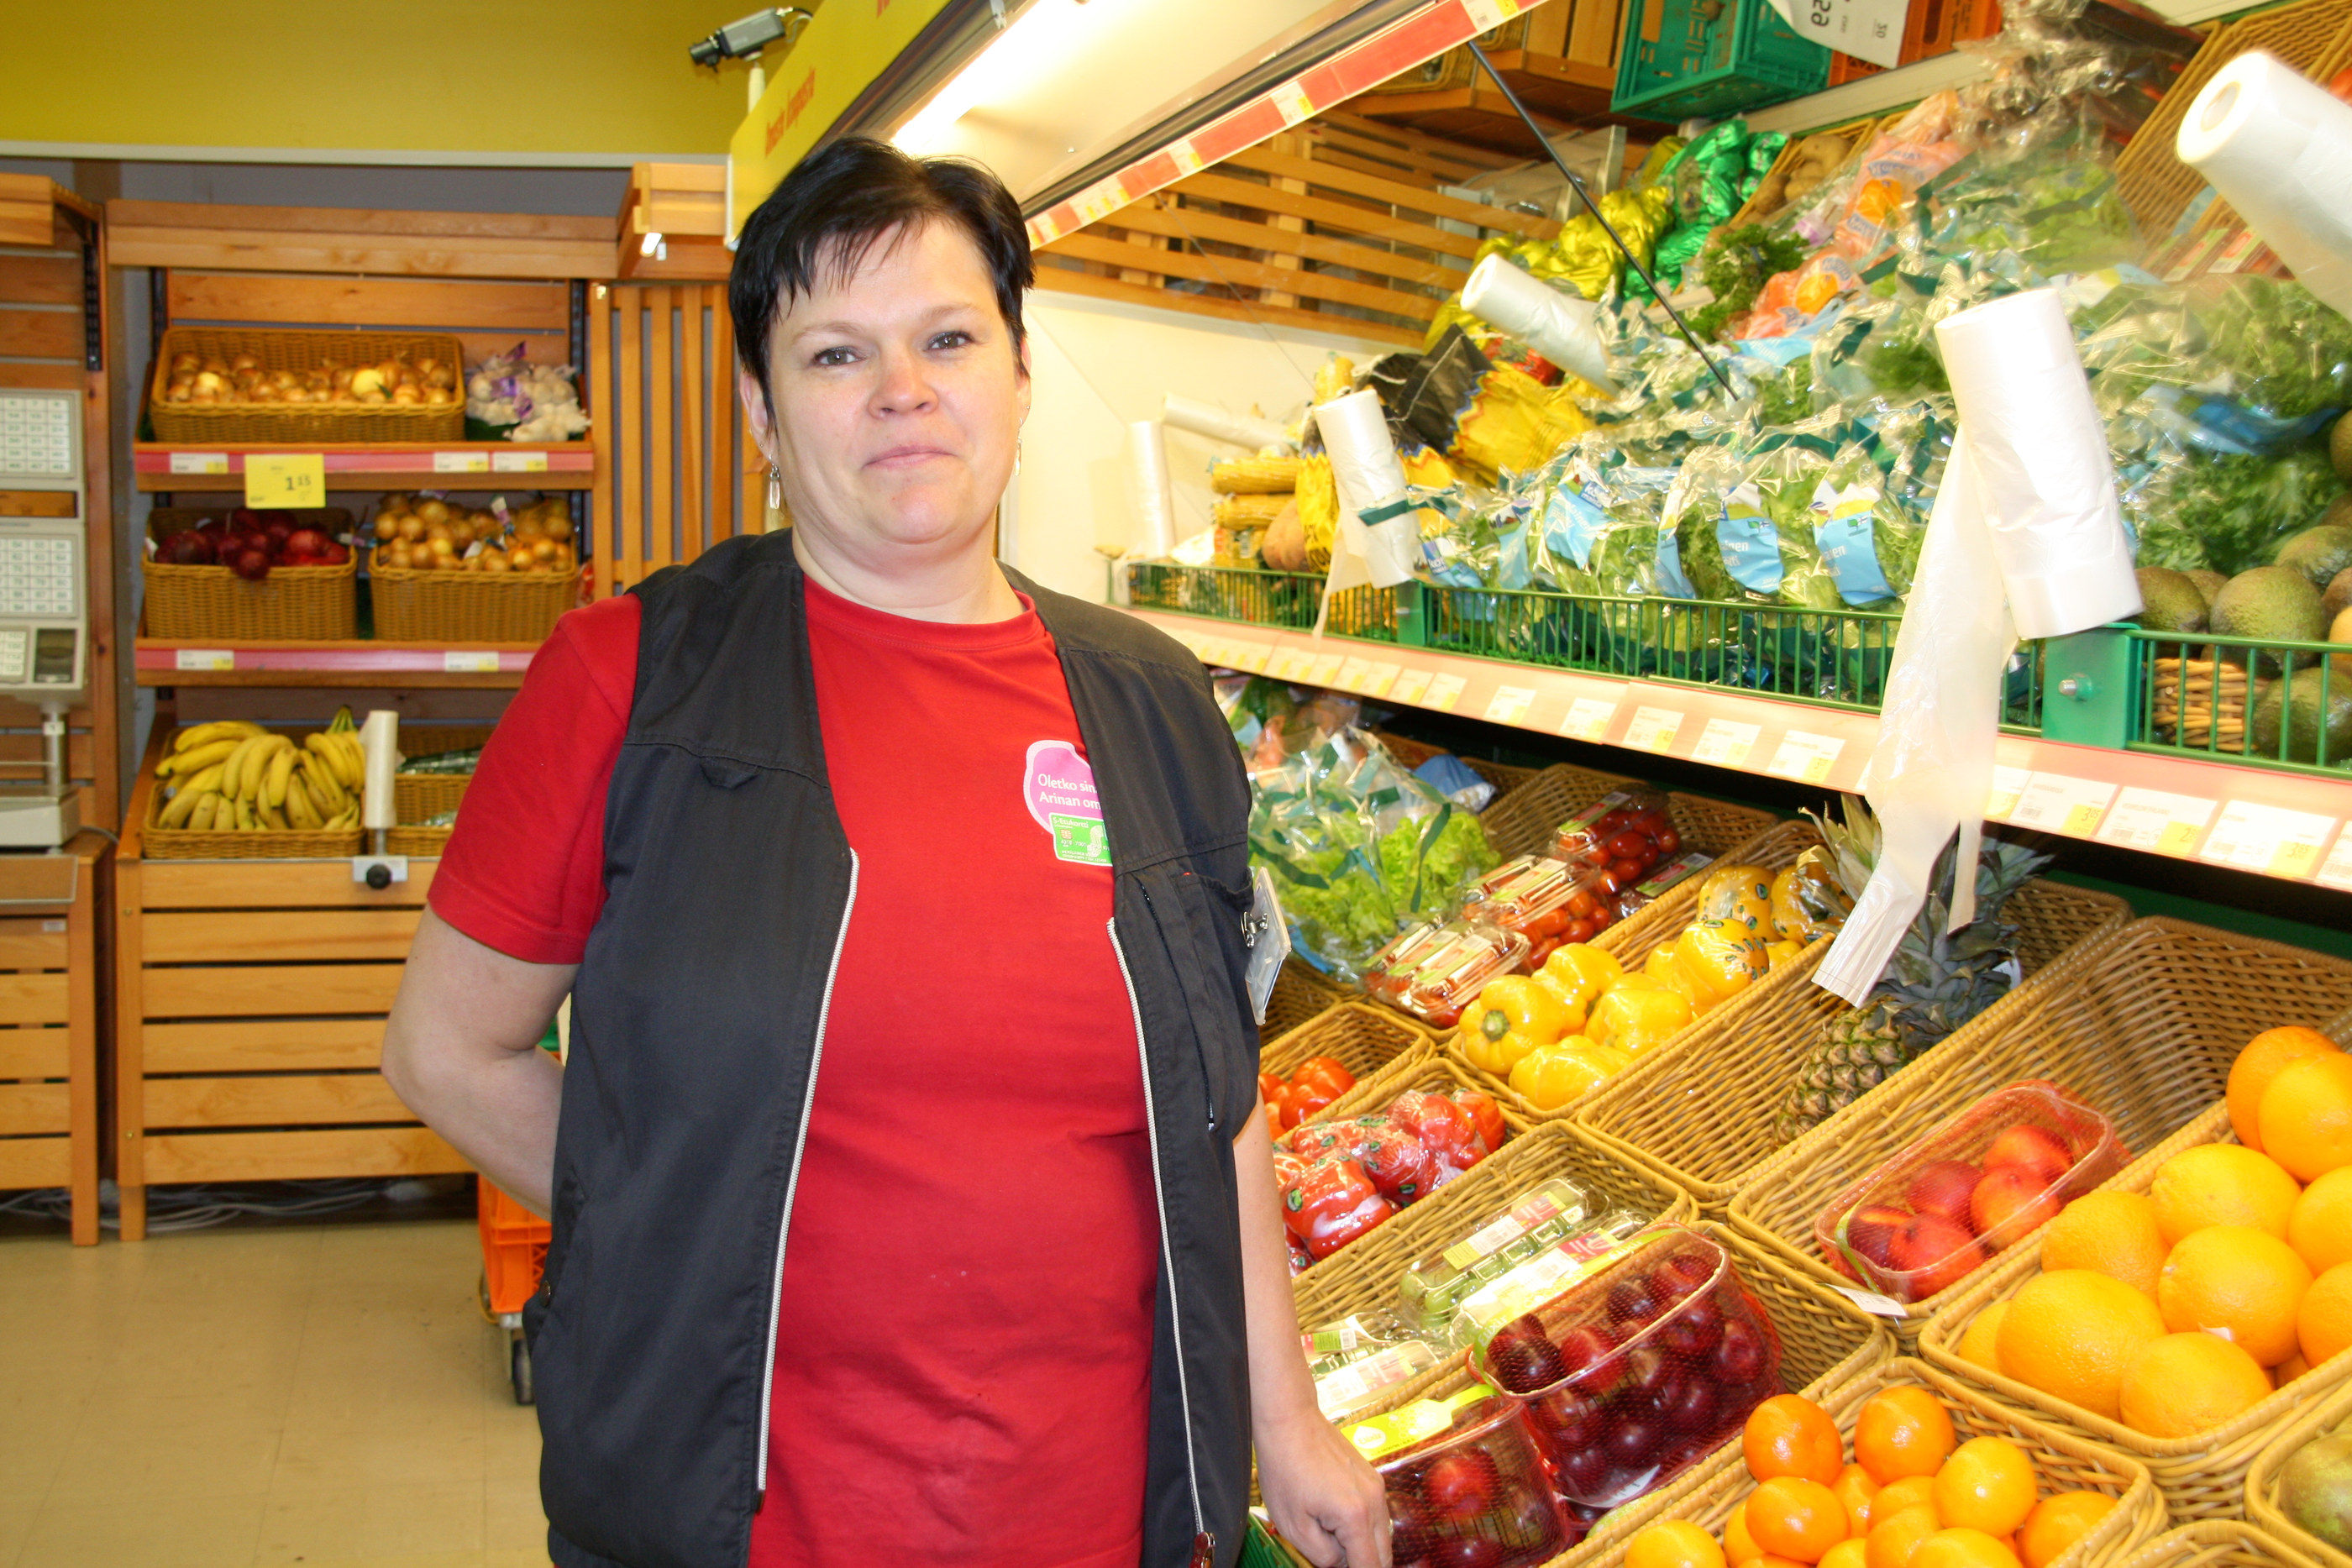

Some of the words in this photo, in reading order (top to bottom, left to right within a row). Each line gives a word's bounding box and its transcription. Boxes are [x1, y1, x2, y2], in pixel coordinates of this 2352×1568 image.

[1037, 774, 1078, 791] Oletko
[1079, 780, 1098, 794] sin
[1039, 791, 1081, 807] Arinan
